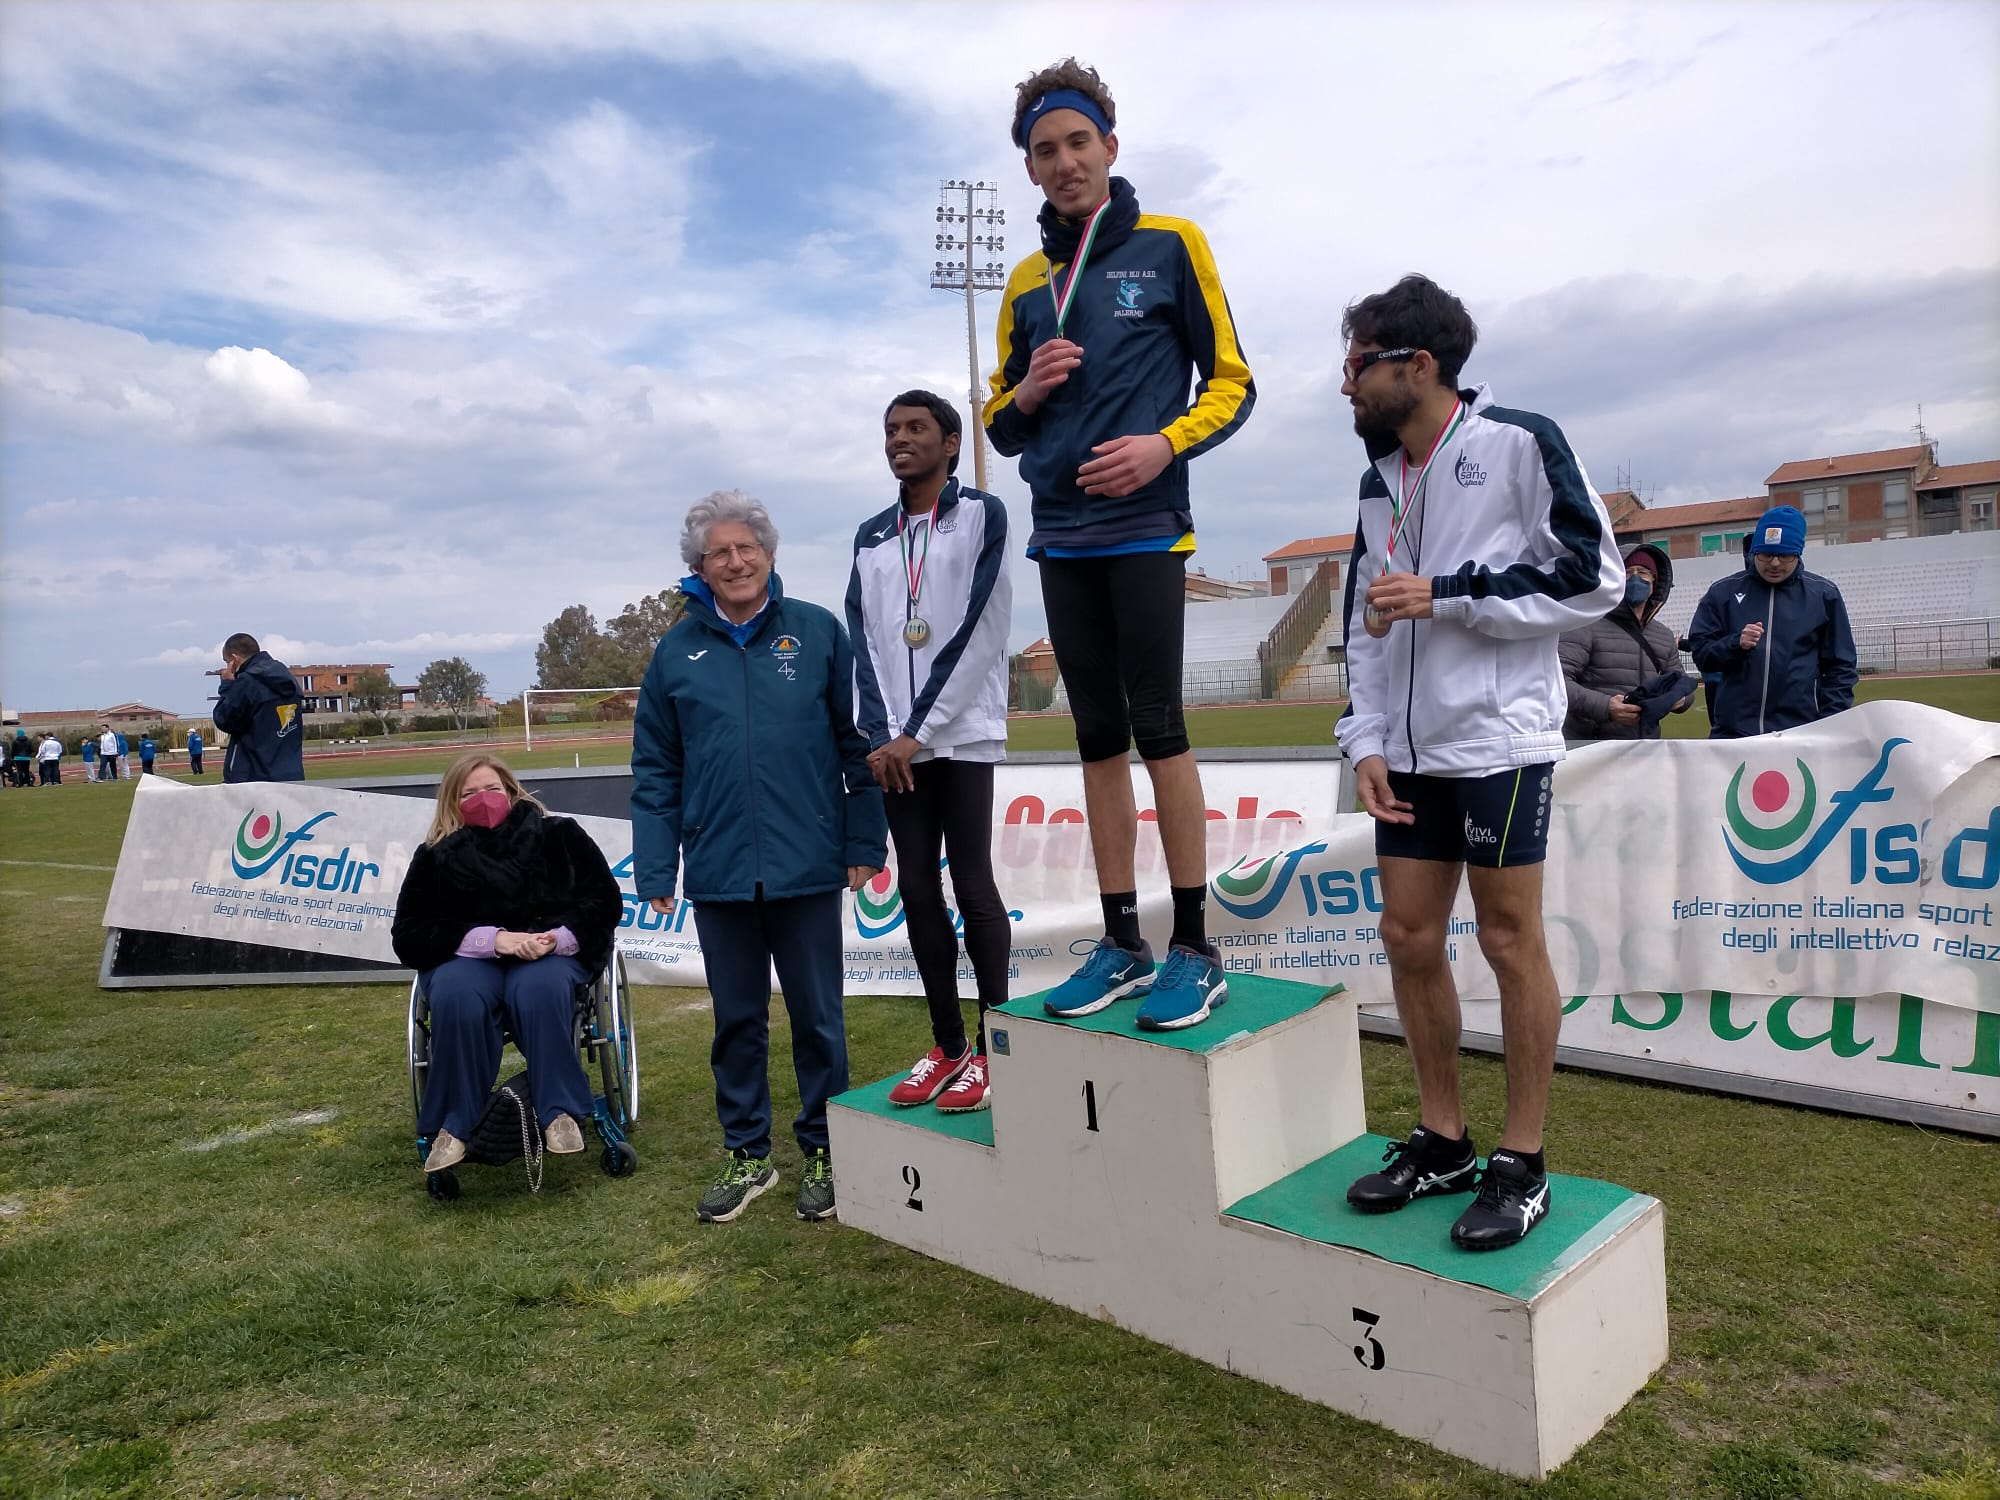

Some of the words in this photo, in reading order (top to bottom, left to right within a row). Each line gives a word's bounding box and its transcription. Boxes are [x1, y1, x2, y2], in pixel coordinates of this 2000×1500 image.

[1106, 271, 1128, 279] DELFINI
[1113, 309, 1144, 318] PALERMO
[1460, 471, 1487, 480] sano
[1461, 463, 1480, 471] VIVI
[1468, 825, 1491, 837] VIVI
[1469, 834, 1497, 844] sano
[191, 881, 255, 900] federazione
[258, 888, 299, 906] italiana
[303, 897, 334, 911] sport
[337, 900, 396, 919] paralimpic
[213, 901, 239, 919] degli
[242, 903, 301, 924] intellettivo
[305, 914, 364, 933] relazionali
[1672, 896, 1803, 920] federazione
[1812, 896, 1904, 918] italiana
[1918, 902, 1993, 926] sport
[621, 937, 655, 946] sport
[1207, 929, 1278, 948] erazione
[1285, 925, 1346, 945] italiana
[1722, 927, 1778, 953] degli
[1790, 927, 1919, 950] intellettivo
[844, 947, 884, 961] azione
[1224, 952, 1262, 973] degli
[1270, 949, 1360, 969] intellettivo
[844, 964, 874, 982] degli
[878, 965, 921, 981] intellet
[1081, 1079, 1099, 1132] 1
[901, 1164, 924, 1213] 2
[1352, 1306, 1386, 1371] 3
